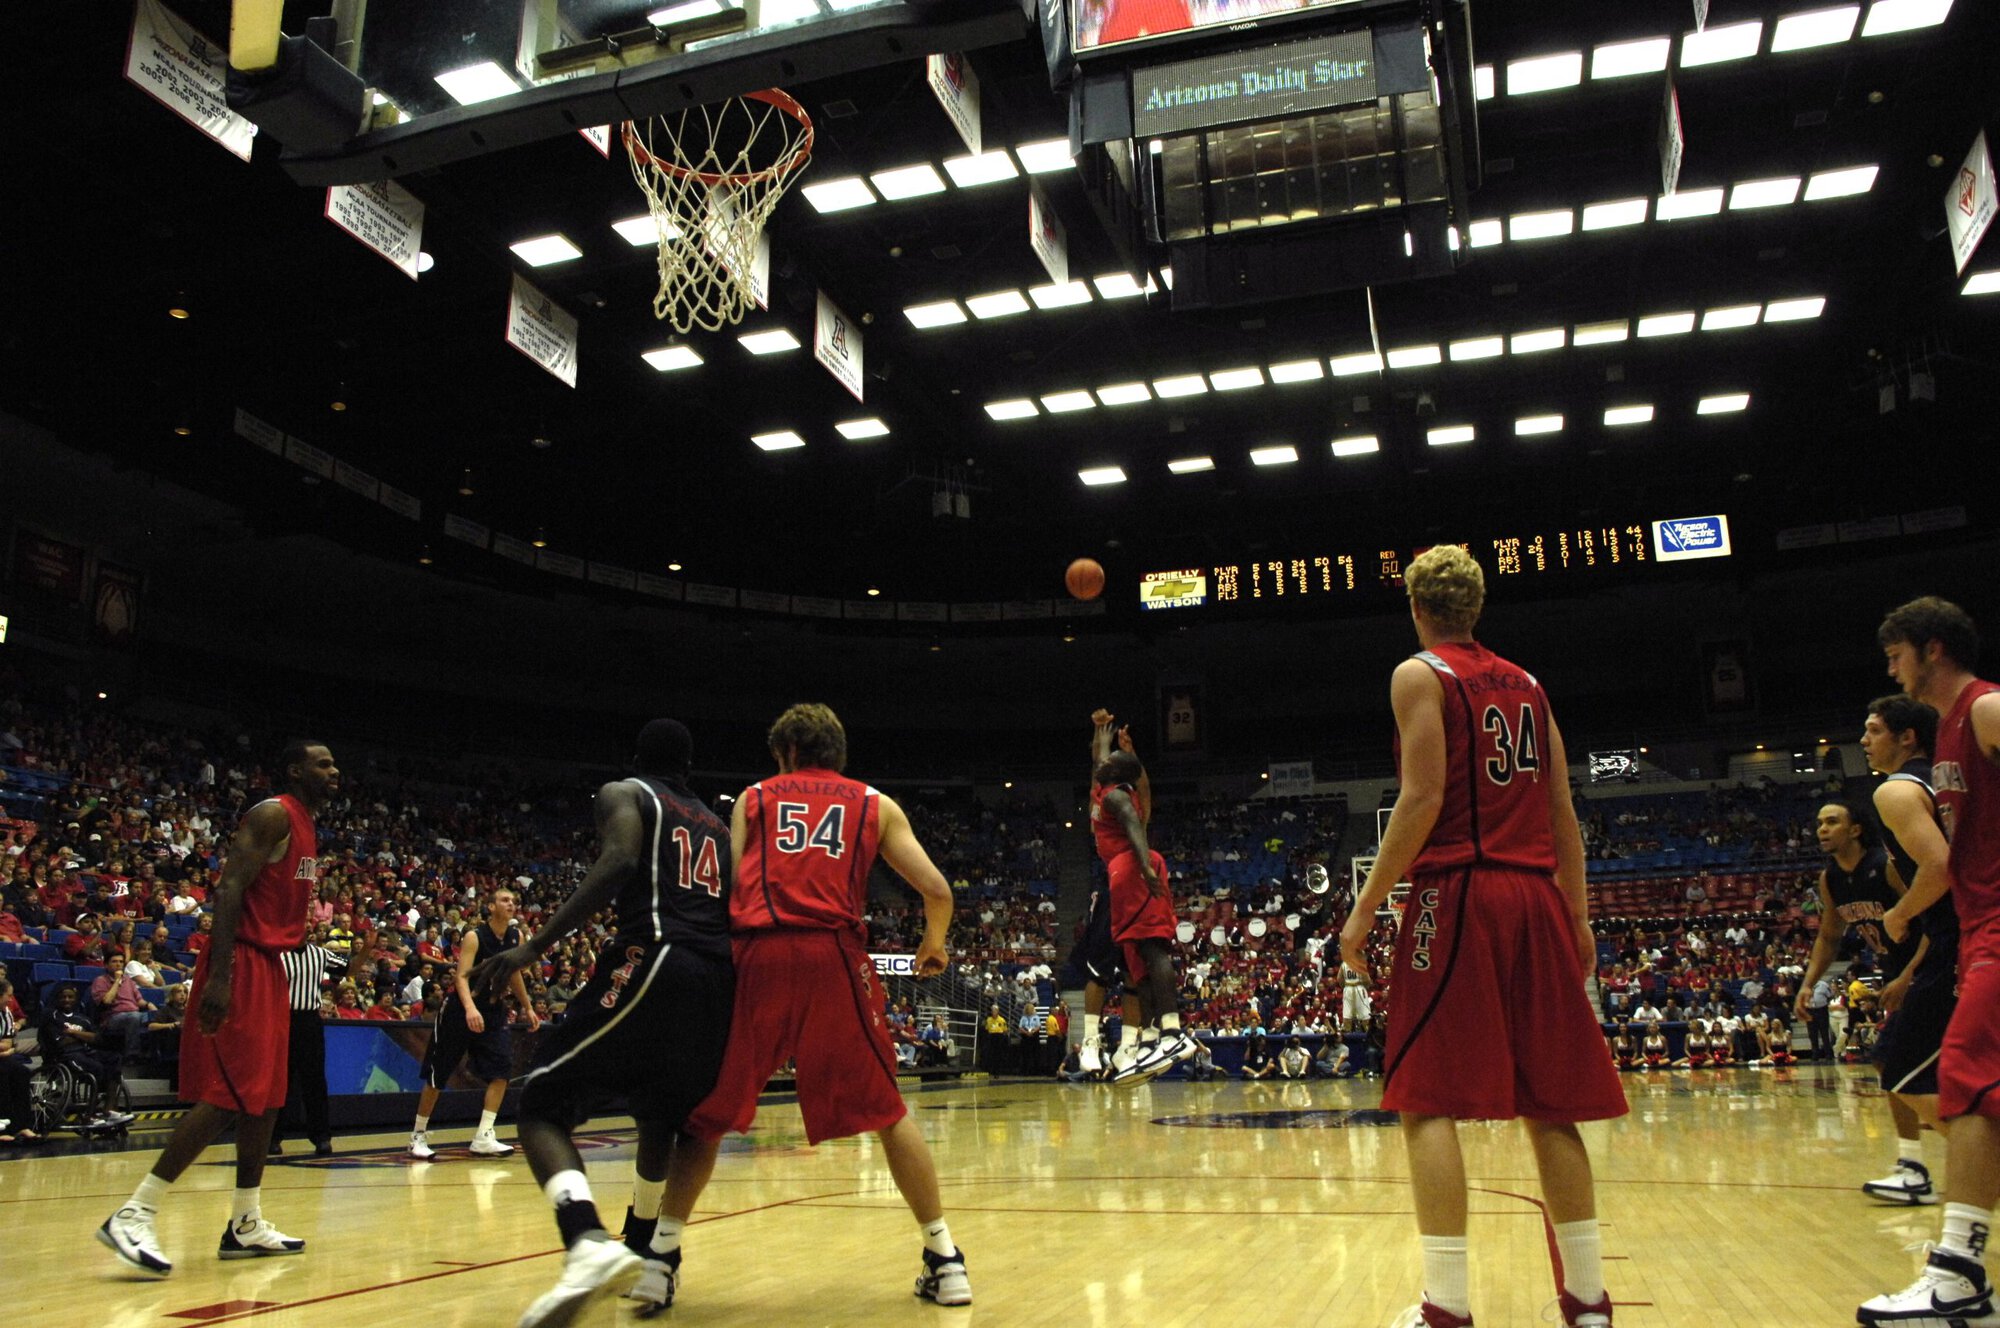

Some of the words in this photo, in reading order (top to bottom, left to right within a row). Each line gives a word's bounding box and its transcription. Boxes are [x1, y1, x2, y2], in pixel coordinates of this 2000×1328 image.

[153, 50, 176, 73] NCAA
[178, 69, 228, 108] TOURNAME
[155, 64, 177, 86] 2002
[1145, 80, 1237, 111] Arizona
[1242, 67, 1307, 96] Daily
[1314, 59, 1366, 84] Star
[347, 190, 365, 208] NCAA
[366, 205, 409, 240] TOURNAMENT
[349, 203, 365, 219] 1992
[370, 218, 386, 233] 1993
[363, 230, 380, 246] 2000
[377, 231, 393, 246] 1997
[1674, 523, 1708, 532] Tucson
[1679, 528, 1716, 539] Electric
[1493, 538, 1520, 549] PLYR
[1626, 525, 1642, 535] 44
[1684, 537, 1717, 547] Power
[1380, 551, 1395, 559] RED
[1499, 547, 1518, 556] PTS
[1214, 565, 1239, 577] PLYR
[1268, 561, 1283, 571] 20
[1291, 559, 1306, 568] 34
[1314, 557, 1329, 567] 50
[1338, 555, 1353, 565] 54
[1498, 556, 1519, 565] RBS
[1145, 569, 1199, 582] O'RIELLY
[1218, 574, 1236, 584] PTS
[1322, 565, 1330, 574] 4
[1499, 564, 1521, 575] FLS
[1217, 582, 1238, 593] RBS
[1253, 588, 1261, 598] 2
[1323, 582, 1331, 591] 4
[1147, 597, 1202, 610] WATSON
[1172, 711, 1191, 724] 32
[1483, 703, 1540, 786] 34
[767, 781, 860, 800] WALTERS
[775, 801, 846, 860] 54
[672, 826, 722, 898] 14
[1411, 888, 1439, 971] CATS
[873, 958, 918, 972] EIC
[600, 945, 647, 1009] CATS
